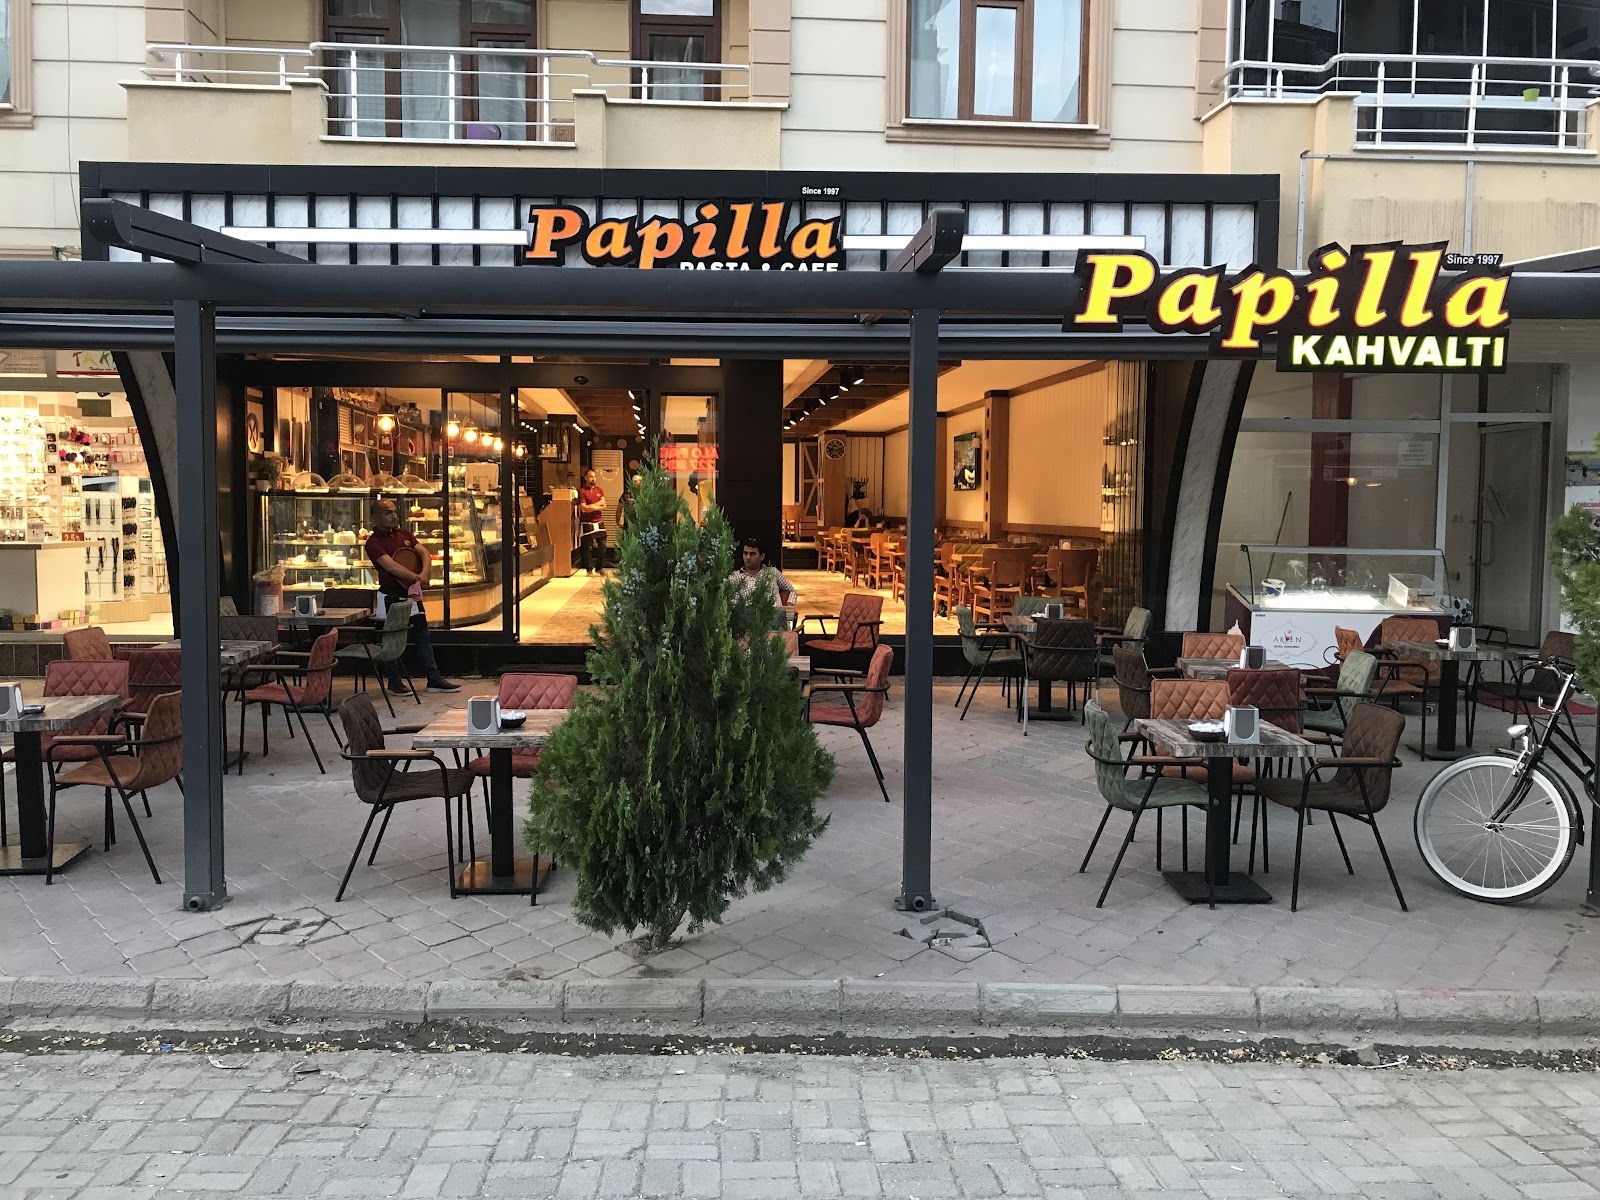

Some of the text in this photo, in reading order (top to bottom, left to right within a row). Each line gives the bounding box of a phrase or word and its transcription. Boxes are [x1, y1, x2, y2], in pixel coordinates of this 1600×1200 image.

[801, 186, 840, 196] Since 1997
[525, 202, 839, 270] Papilla
[1446, 254, 1500, 265] Since 1997
[1074, 249, 1510, 349] Papilla
[1292, 334, 1506, 367] KAHVALTI
